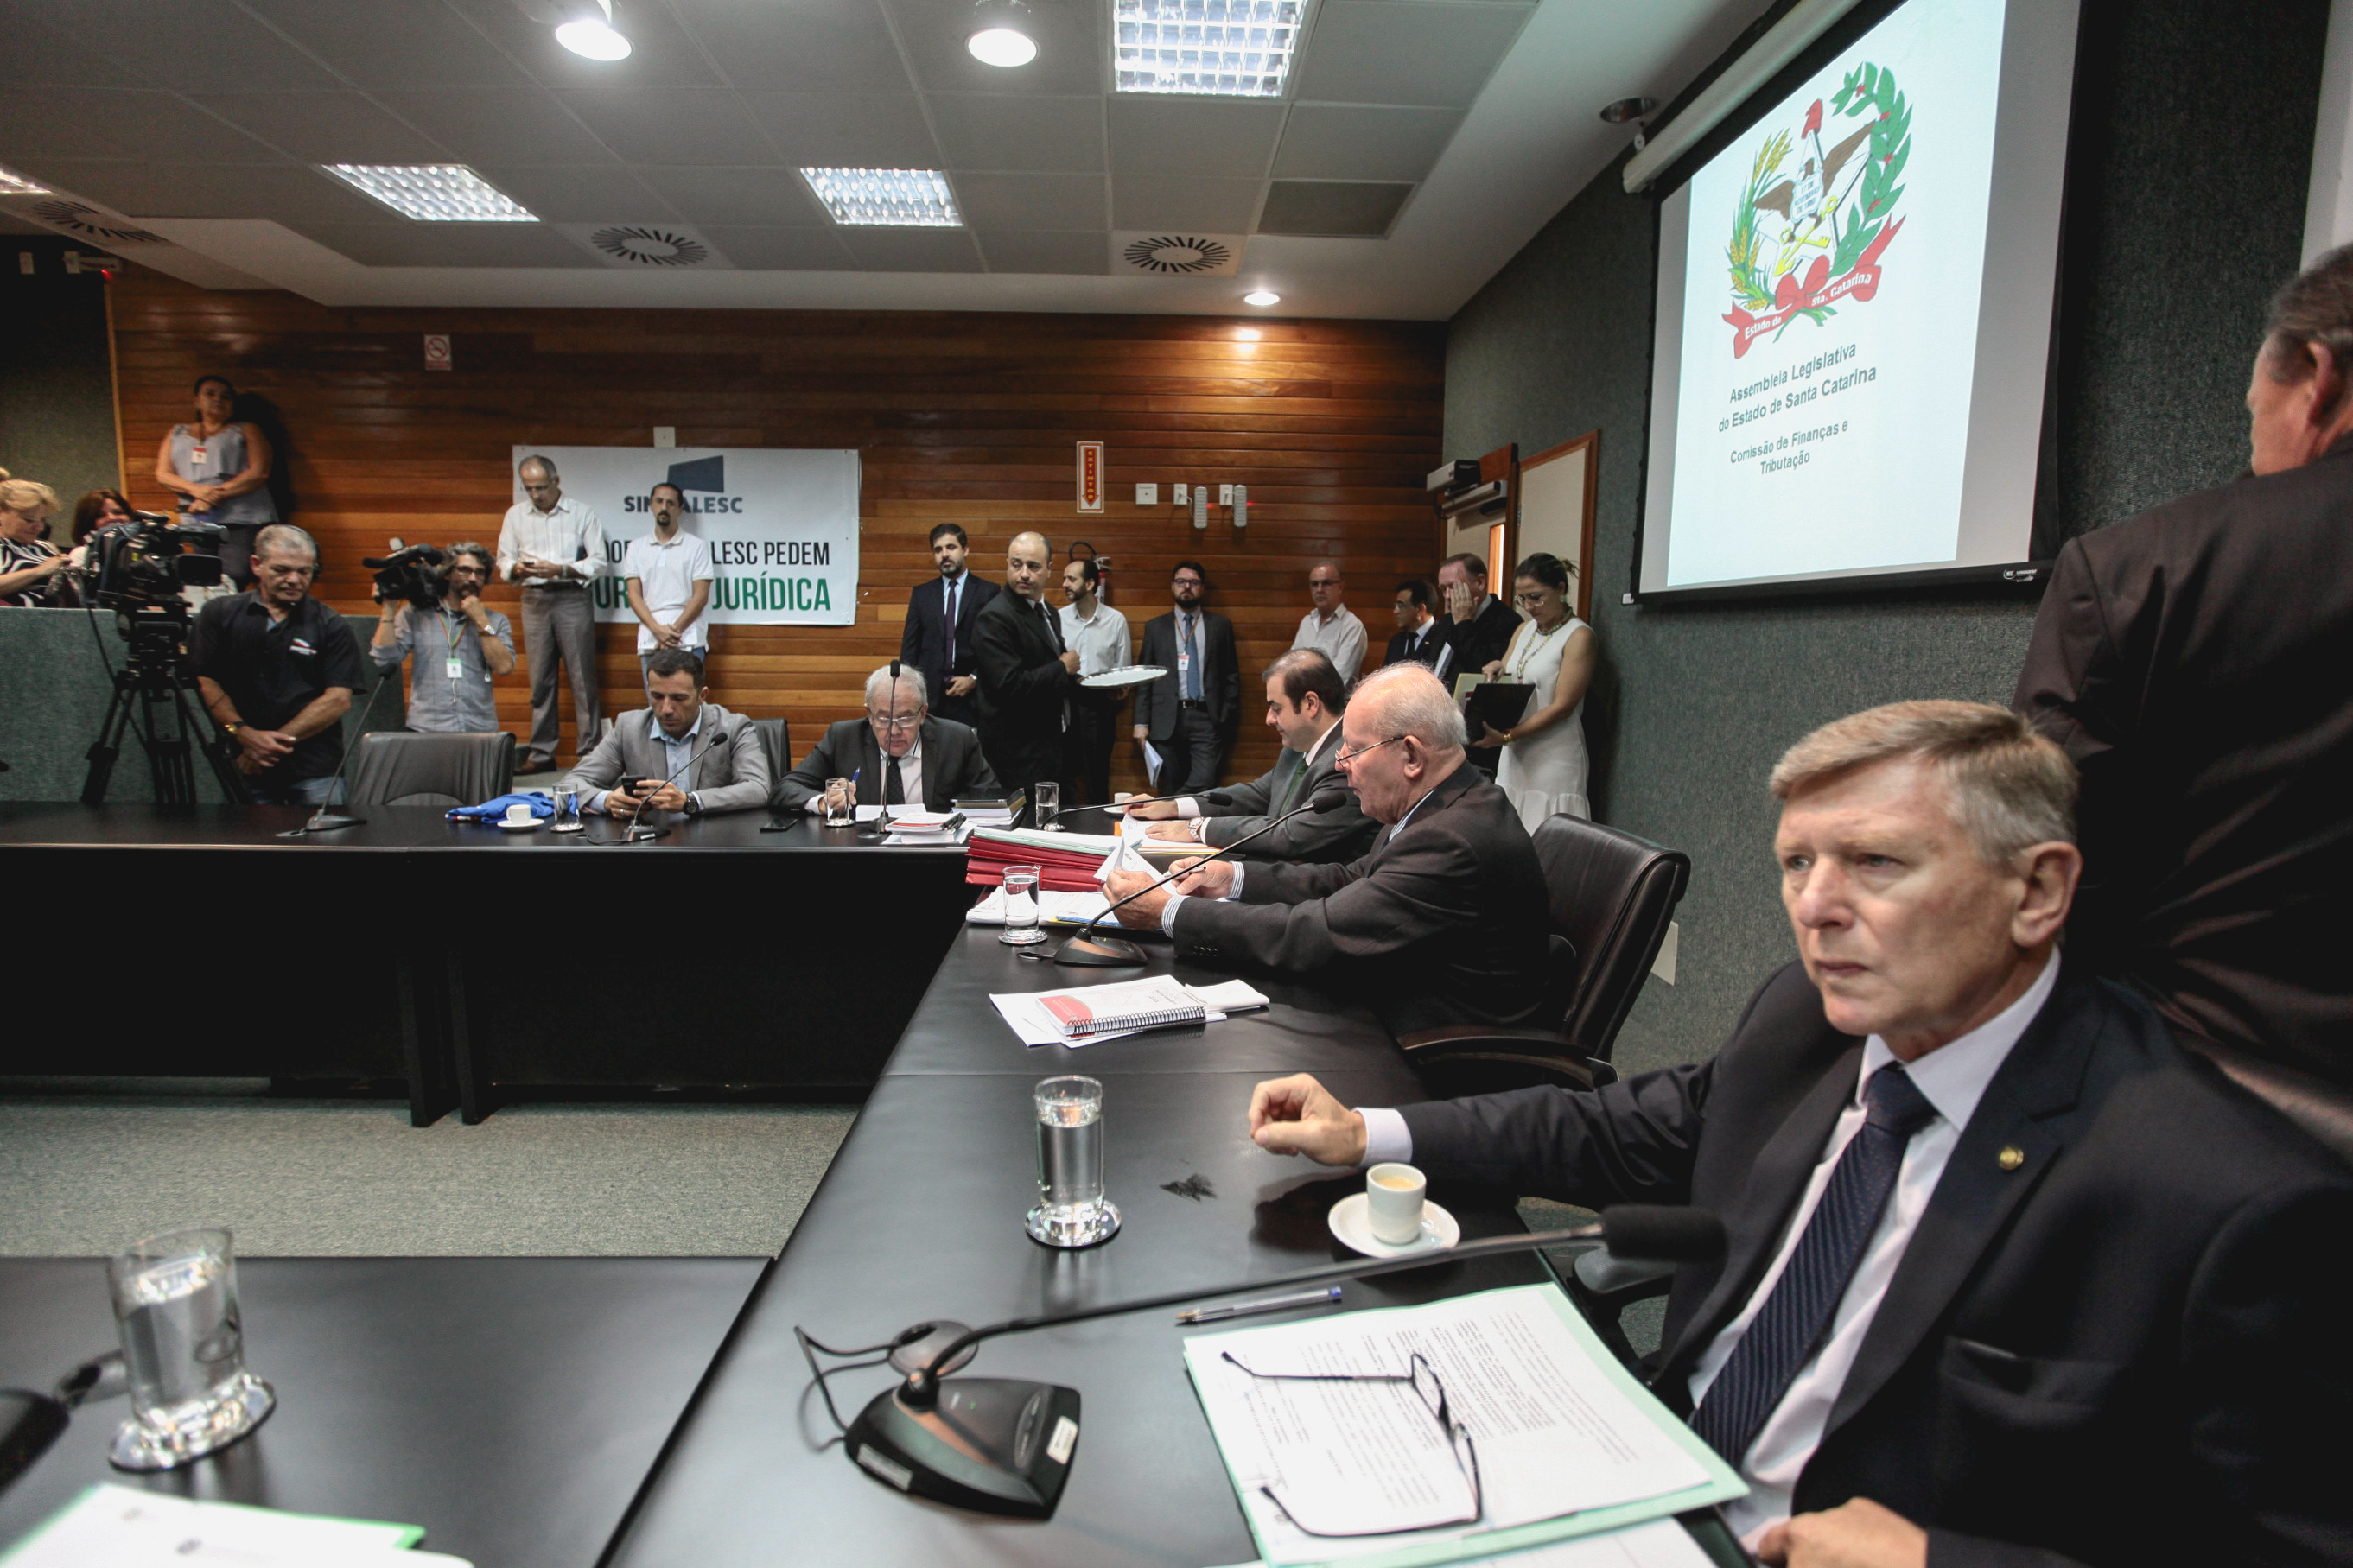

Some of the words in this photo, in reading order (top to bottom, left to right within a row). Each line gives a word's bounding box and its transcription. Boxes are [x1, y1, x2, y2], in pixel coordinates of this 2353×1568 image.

[1830, 272, 1873, 297] Catarina
[1745, 318, 1771, 340] Estado
[1771, 315, 1782, 327] de
[1729, 369, 1788, 404] Assembleia
[1791, 343, 1856, 380] Legislativa
[1718, 417, 1729, 433] do
[1732, 403, 1767, 428] Estado
[1770, 398, 1782, 415] de
[1785, 385, 1817, 409] Santa
[1822, 366, 1877, 397] Catarina
[1730, 440, 1774, 464] Comissão
[1776, 435, 1789, 451] de
[1791, 422, 1840, 448] Finanças
[1841, 419, 1848, 432] e
[1760, 449, 1810, 474] Tributação
[624, 496, 743, 513] SINALESC
[710, 541, 758, 565] LESC
[764, 542, 830, 566] PEDEM
[711, 571, 831, 612] JURÍDICA
